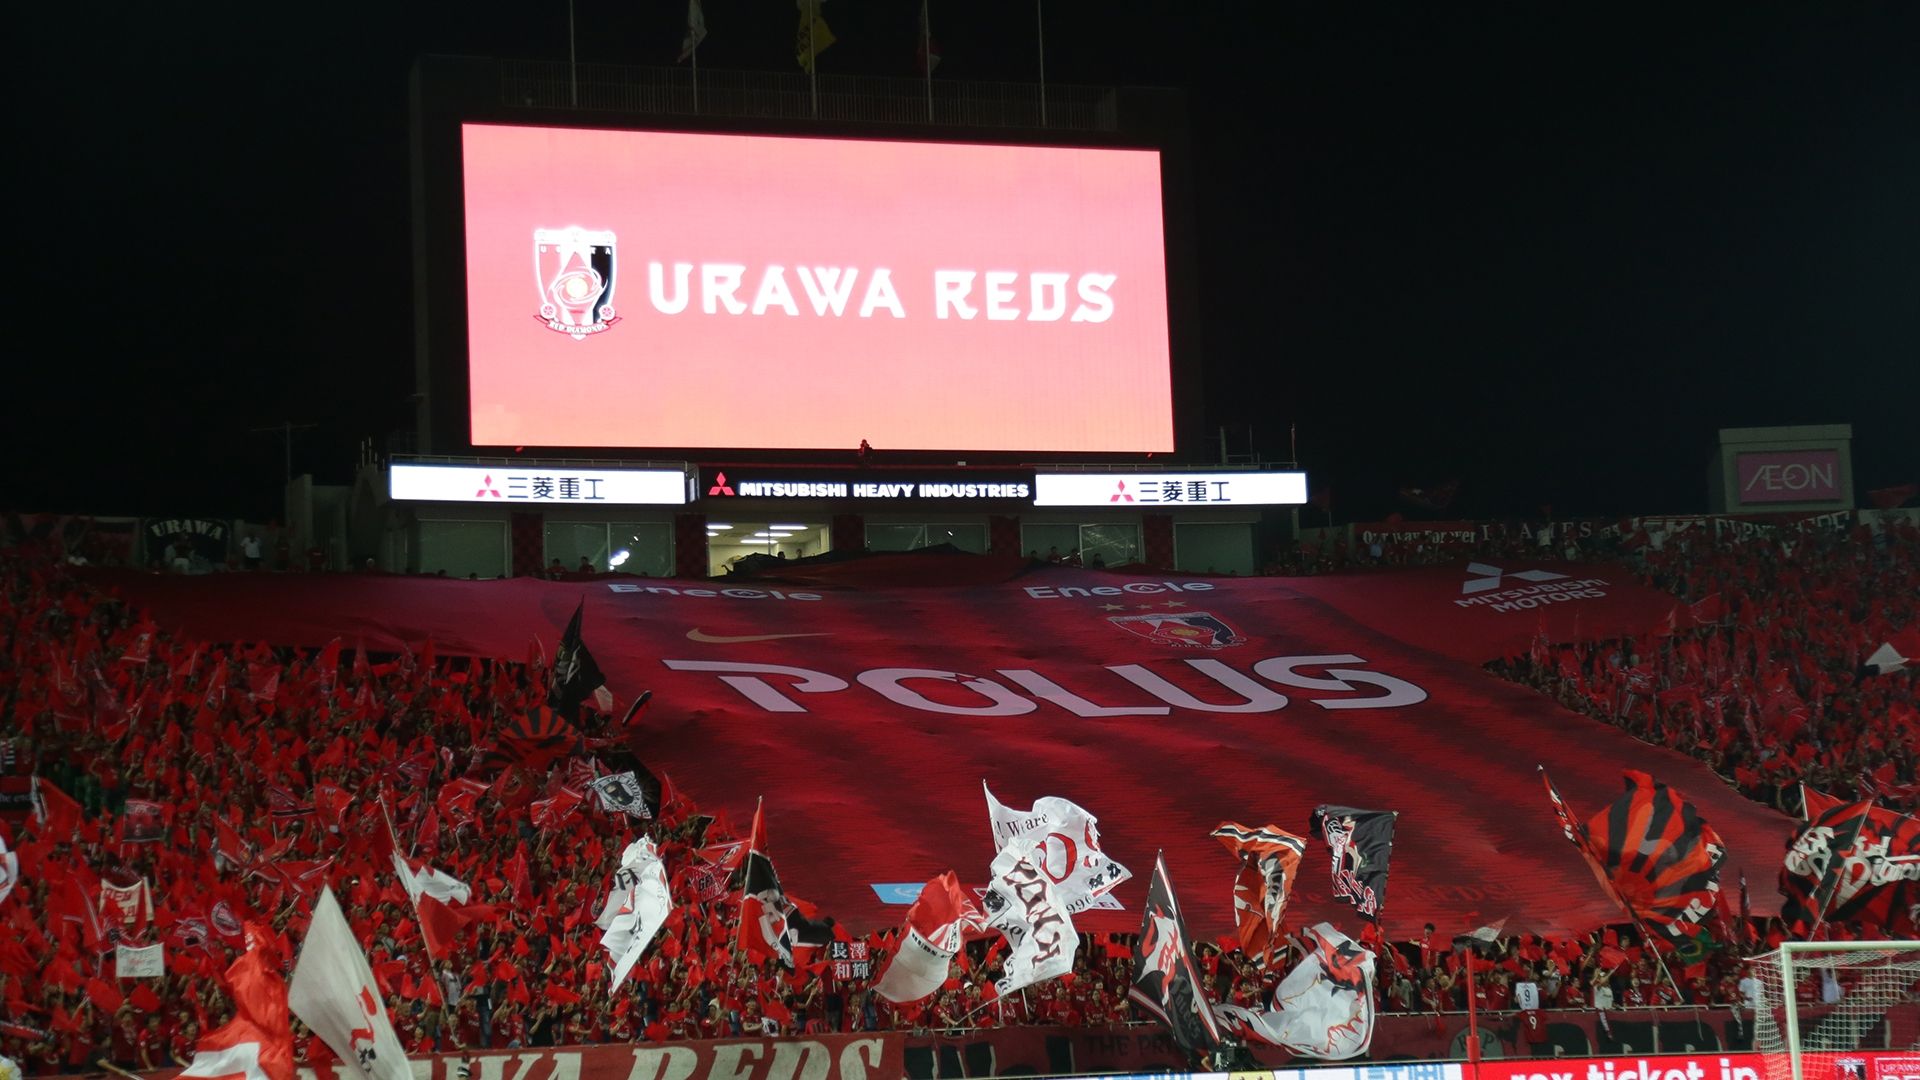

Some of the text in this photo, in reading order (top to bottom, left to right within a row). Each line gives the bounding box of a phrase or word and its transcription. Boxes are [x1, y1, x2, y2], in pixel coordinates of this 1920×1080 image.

[649, 261, 1118, 323] URAWA REDS
[507, 477, 605, 500] 三菱重工
[739, 482, 1030, 498] MITSUBISHI HEAVY INDUSTRIES
[1139, 481, 1231, 502] 三菱重工
[151, 519, 223, 541] URAWA
[1453, 578, 1611, 608] MITSUBISHI
[1489, 588, 1607, 613] MOTORS
[661, 654, 1428, 718] POLUS
[1026, 813, 1048, 830] are
[832, 942, 867, 959] 長澤
[1529, 1015, 1537, 1030] 9
[1084, 1034, 1129, 1056] THE
